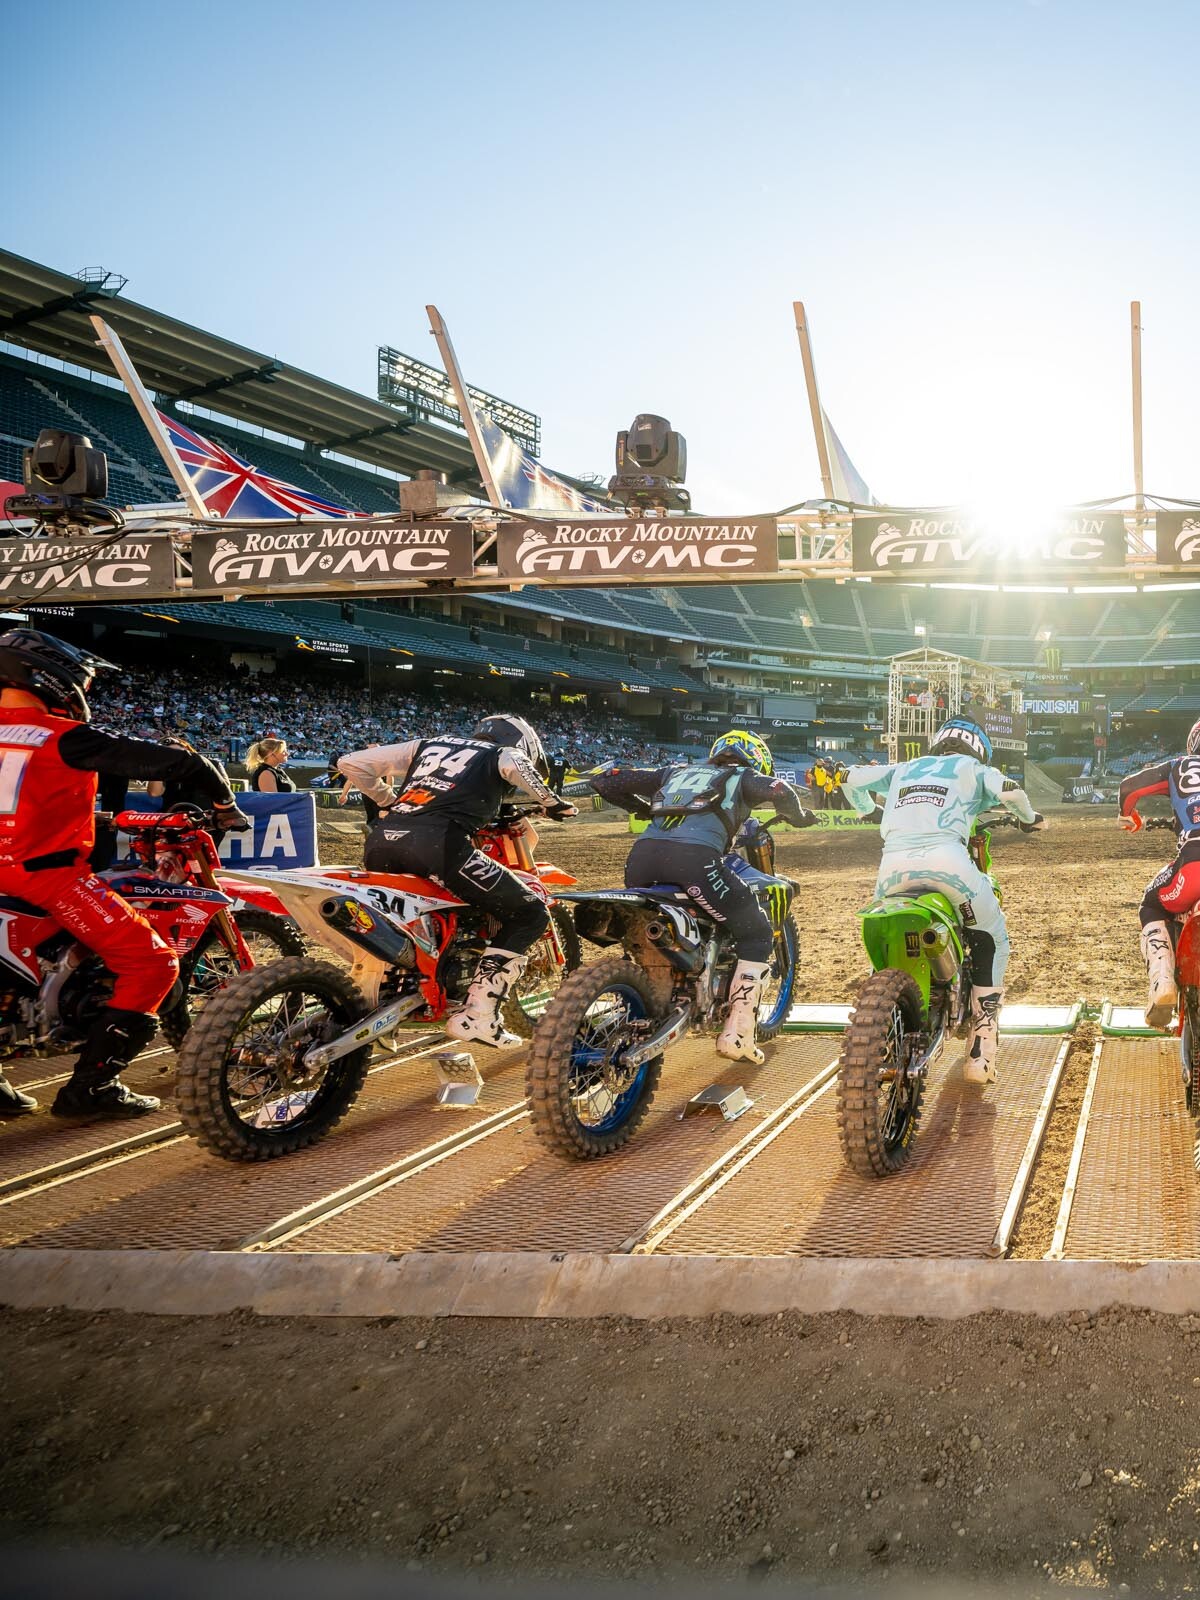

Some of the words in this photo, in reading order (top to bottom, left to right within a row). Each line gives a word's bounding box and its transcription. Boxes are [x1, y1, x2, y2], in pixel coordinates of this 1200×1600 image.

[243, 533, 316, 554] ROCKY
[321, 528, 451, 546] MOUNTAIN
[552, 525, 628, 544] ROCKY
[630, 523, 758, 542] MOUNTAIN
[1023, 699, 1079, 713] FINISH
[985, 712, 996, 721] UTAH
[998, 714, 1012, 724] SPORTS
[412, 746, 479, 777] 34
[900, 756, 964, 781] 21
[667, 773, 713, 793] 14
[895, 796, 945, 809] Kawasaki
[134, 885, 213, 898] SMARTOP
[1160, 872, 1185, 902] GASGAS
[366, 888, 406, 918] 34
[176, 917, 206, 926] HONDA
